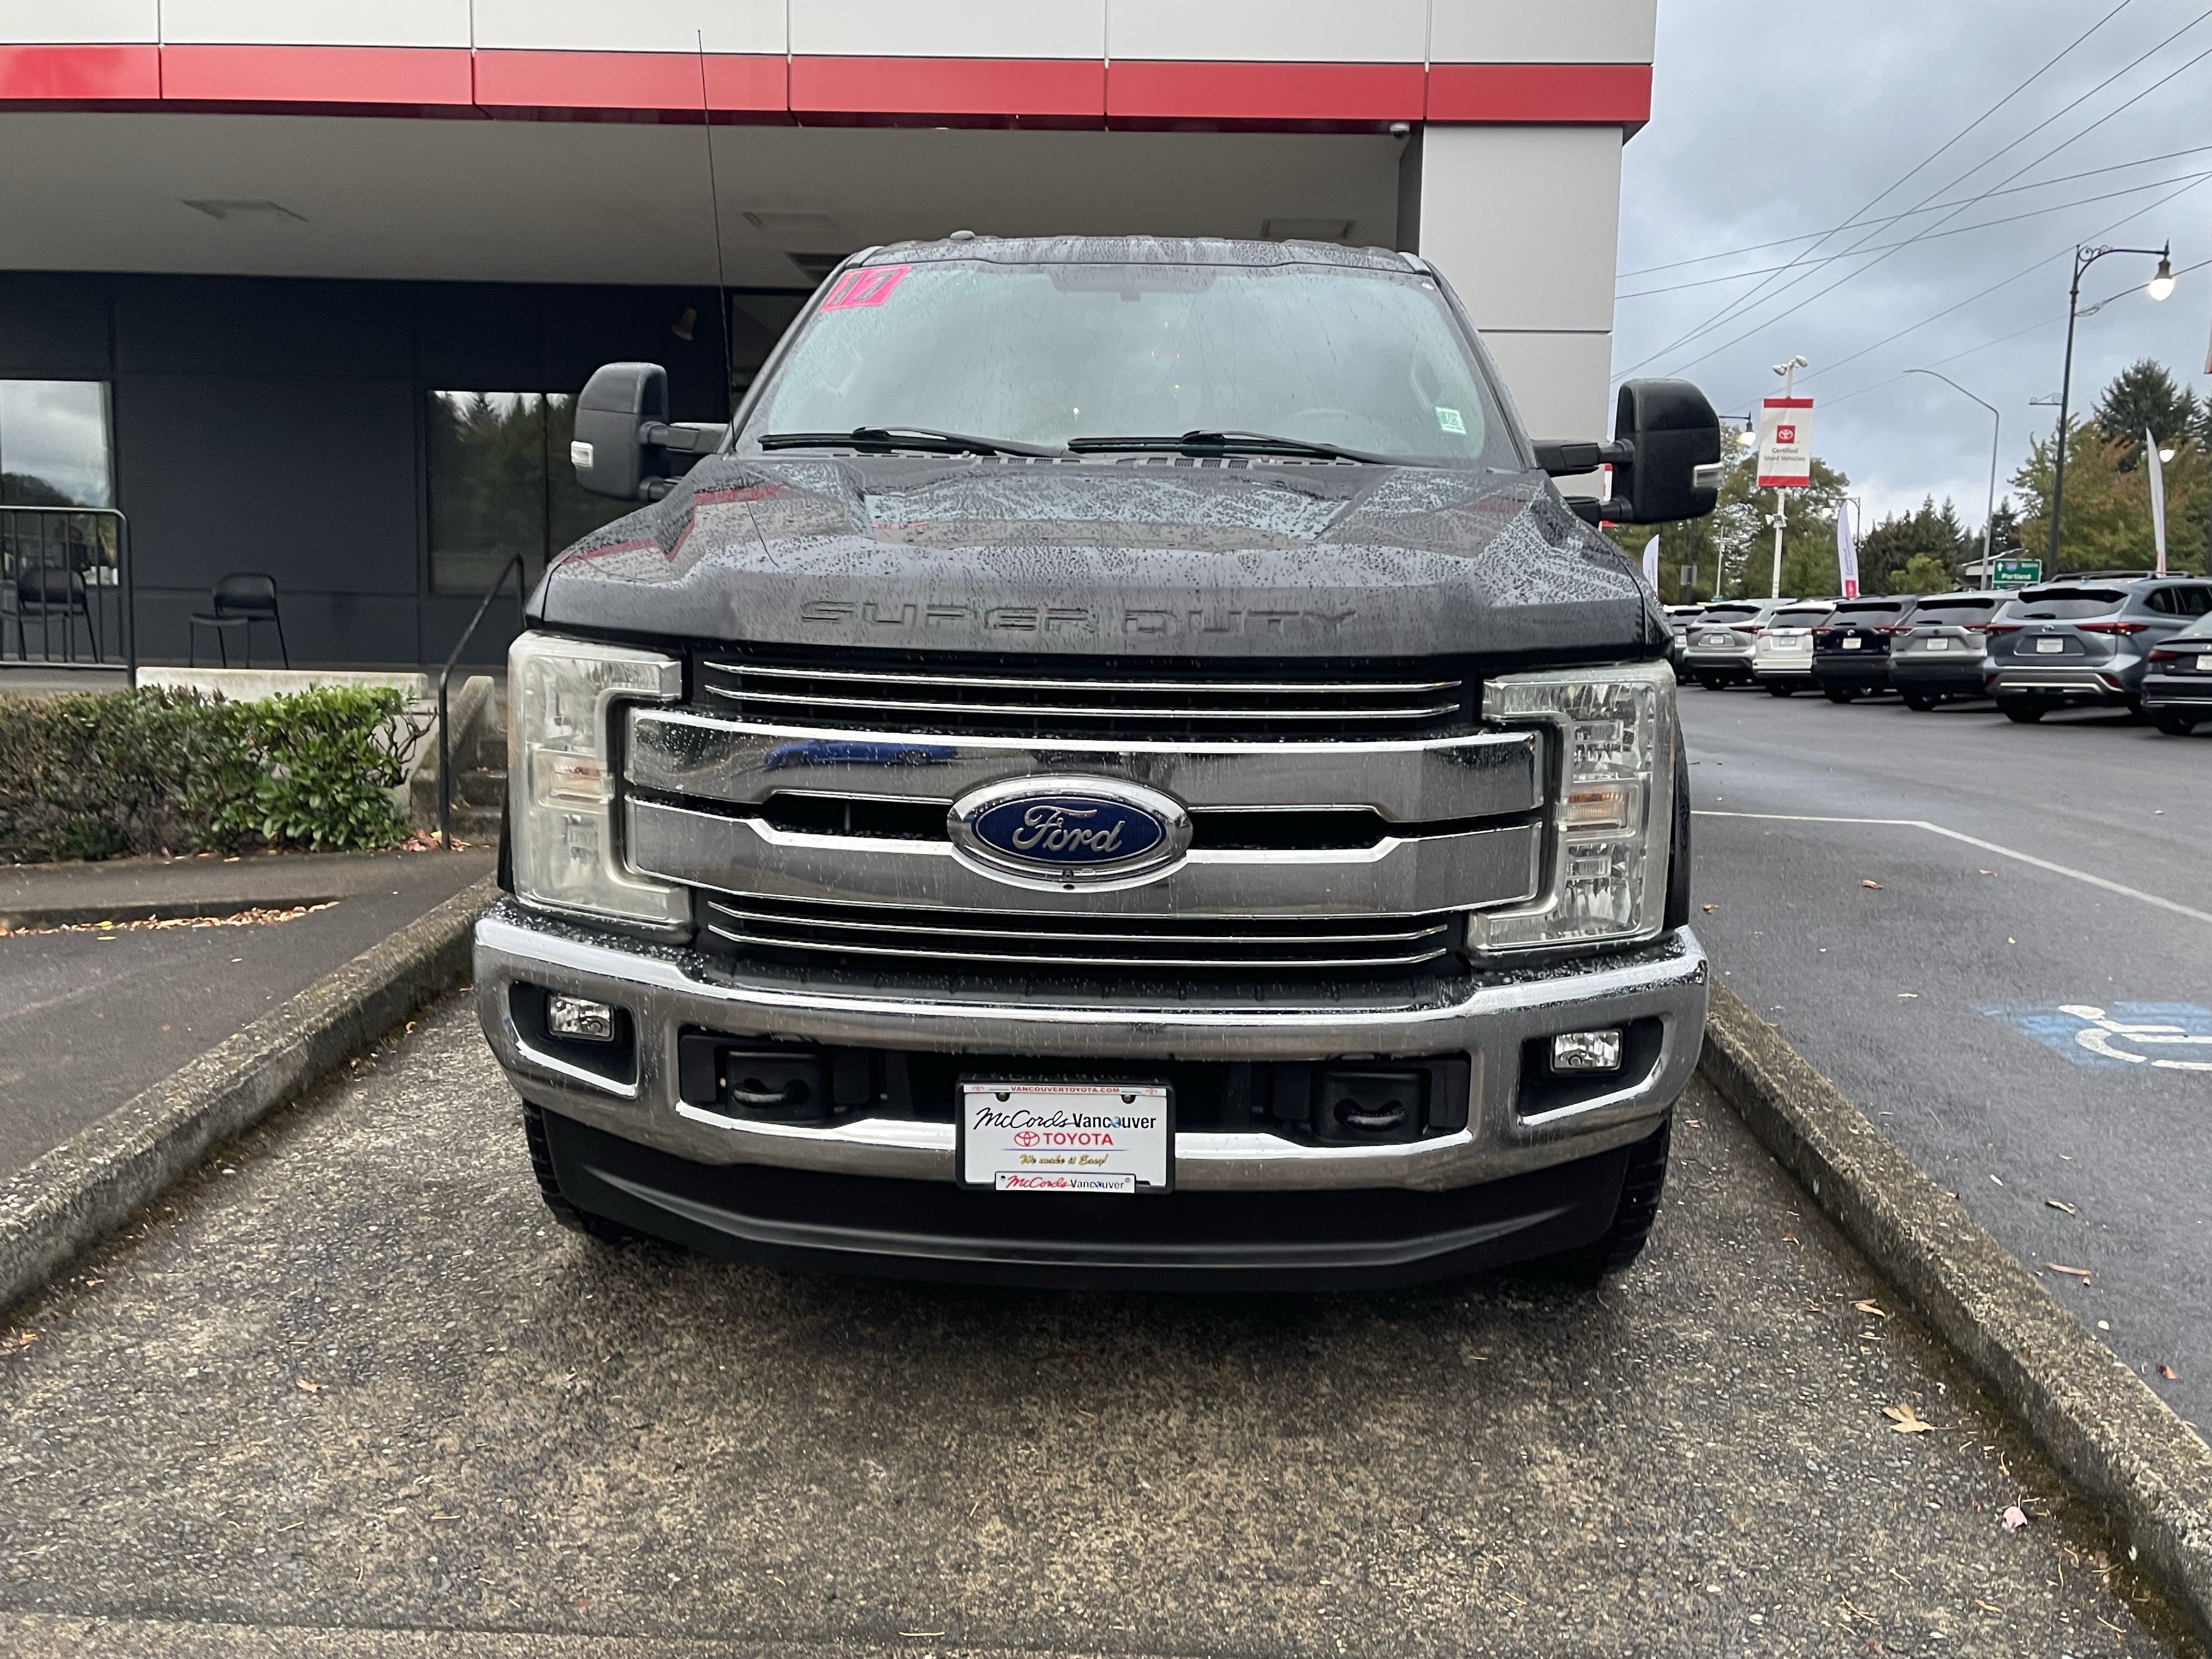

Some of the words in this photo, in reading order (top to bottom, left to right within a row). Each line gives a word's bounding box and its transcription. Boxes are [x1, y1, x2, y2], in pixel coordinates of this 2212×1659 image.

[830, 269, 901, 306] 17
[802, 600, 1094, 633] SUPER
[1122, 609, 1357, 635] DUTY
[1012, 805, 1125, 852] Ford
[1043, 1133, 1114, 1146] TOYOTA
[1019, 1154, 1036, 1165] We
[1039, 1154, 1065, 1165] make
[1079, 1153, 1109, 1167] Easy!
